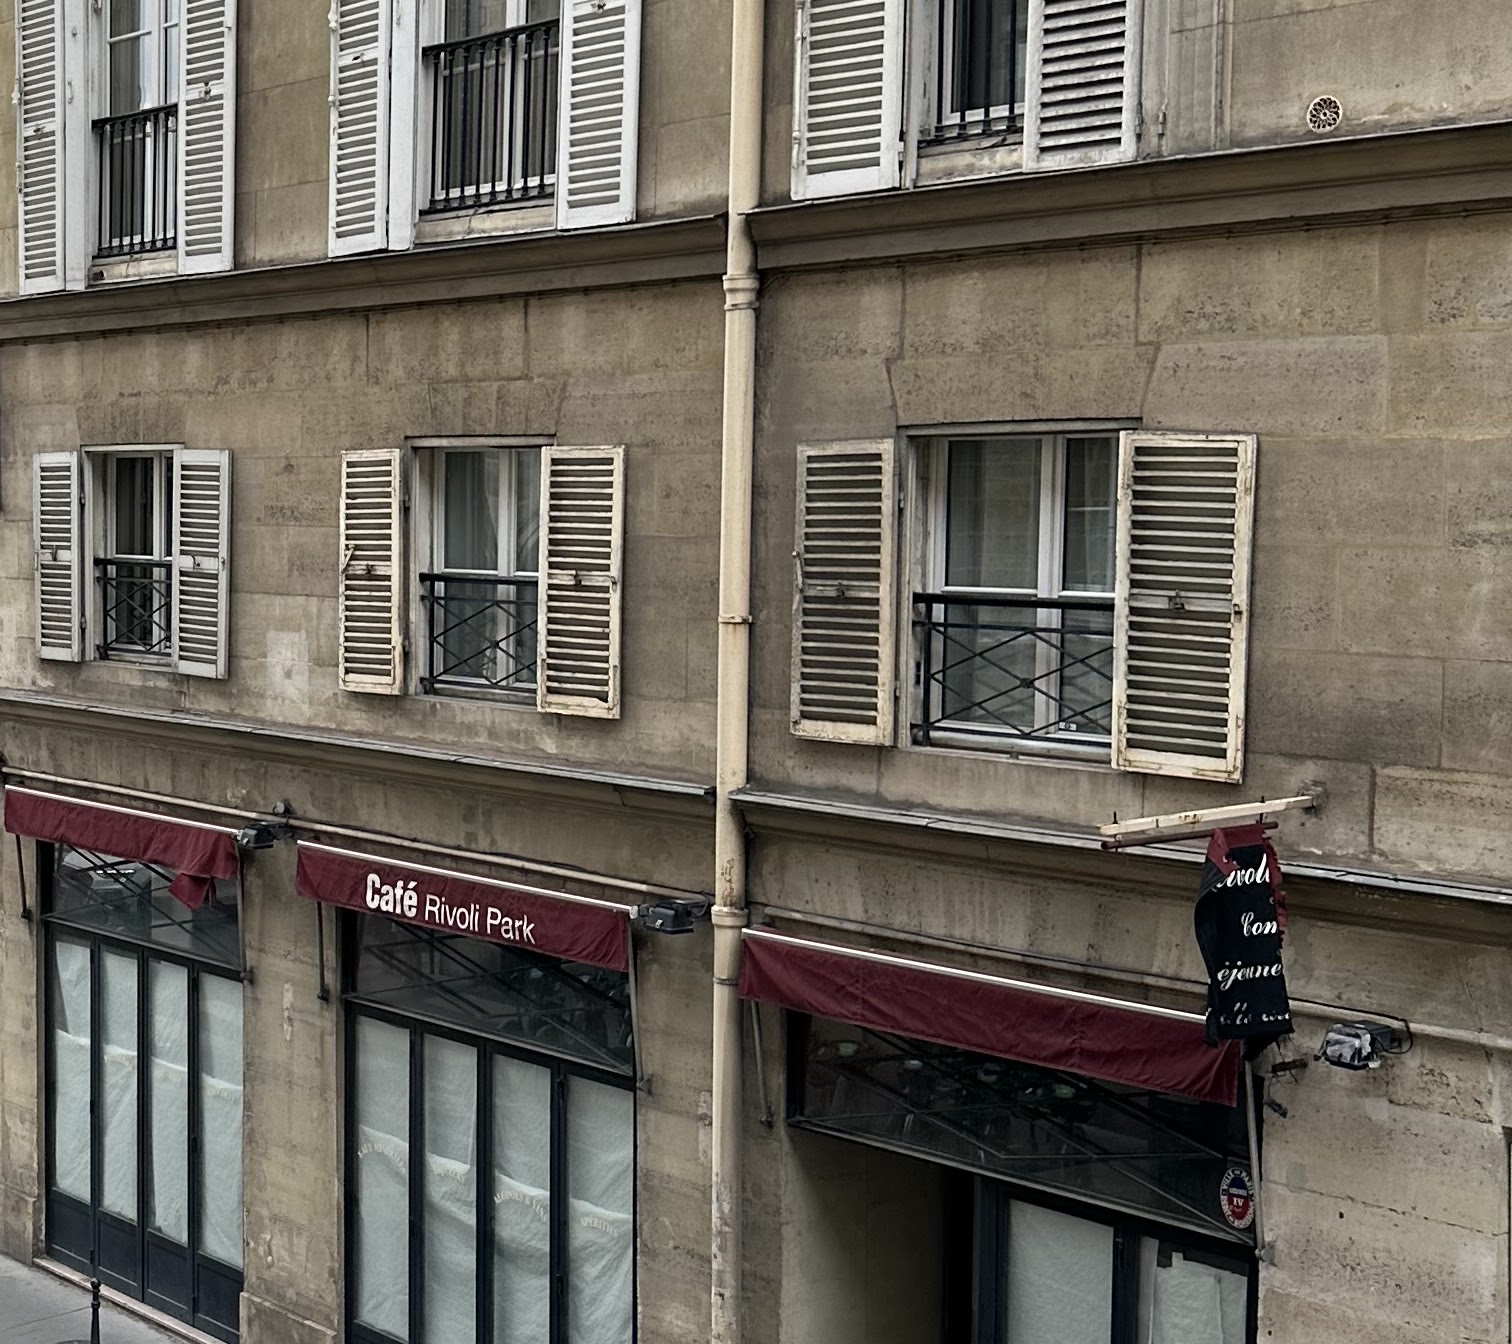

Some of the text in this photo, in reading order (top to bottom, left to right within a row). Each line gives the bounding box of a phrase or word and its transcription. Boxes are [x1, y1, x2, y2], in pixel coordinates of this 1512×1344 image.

[366, 873, 536, 944] Café Rivoli Park
